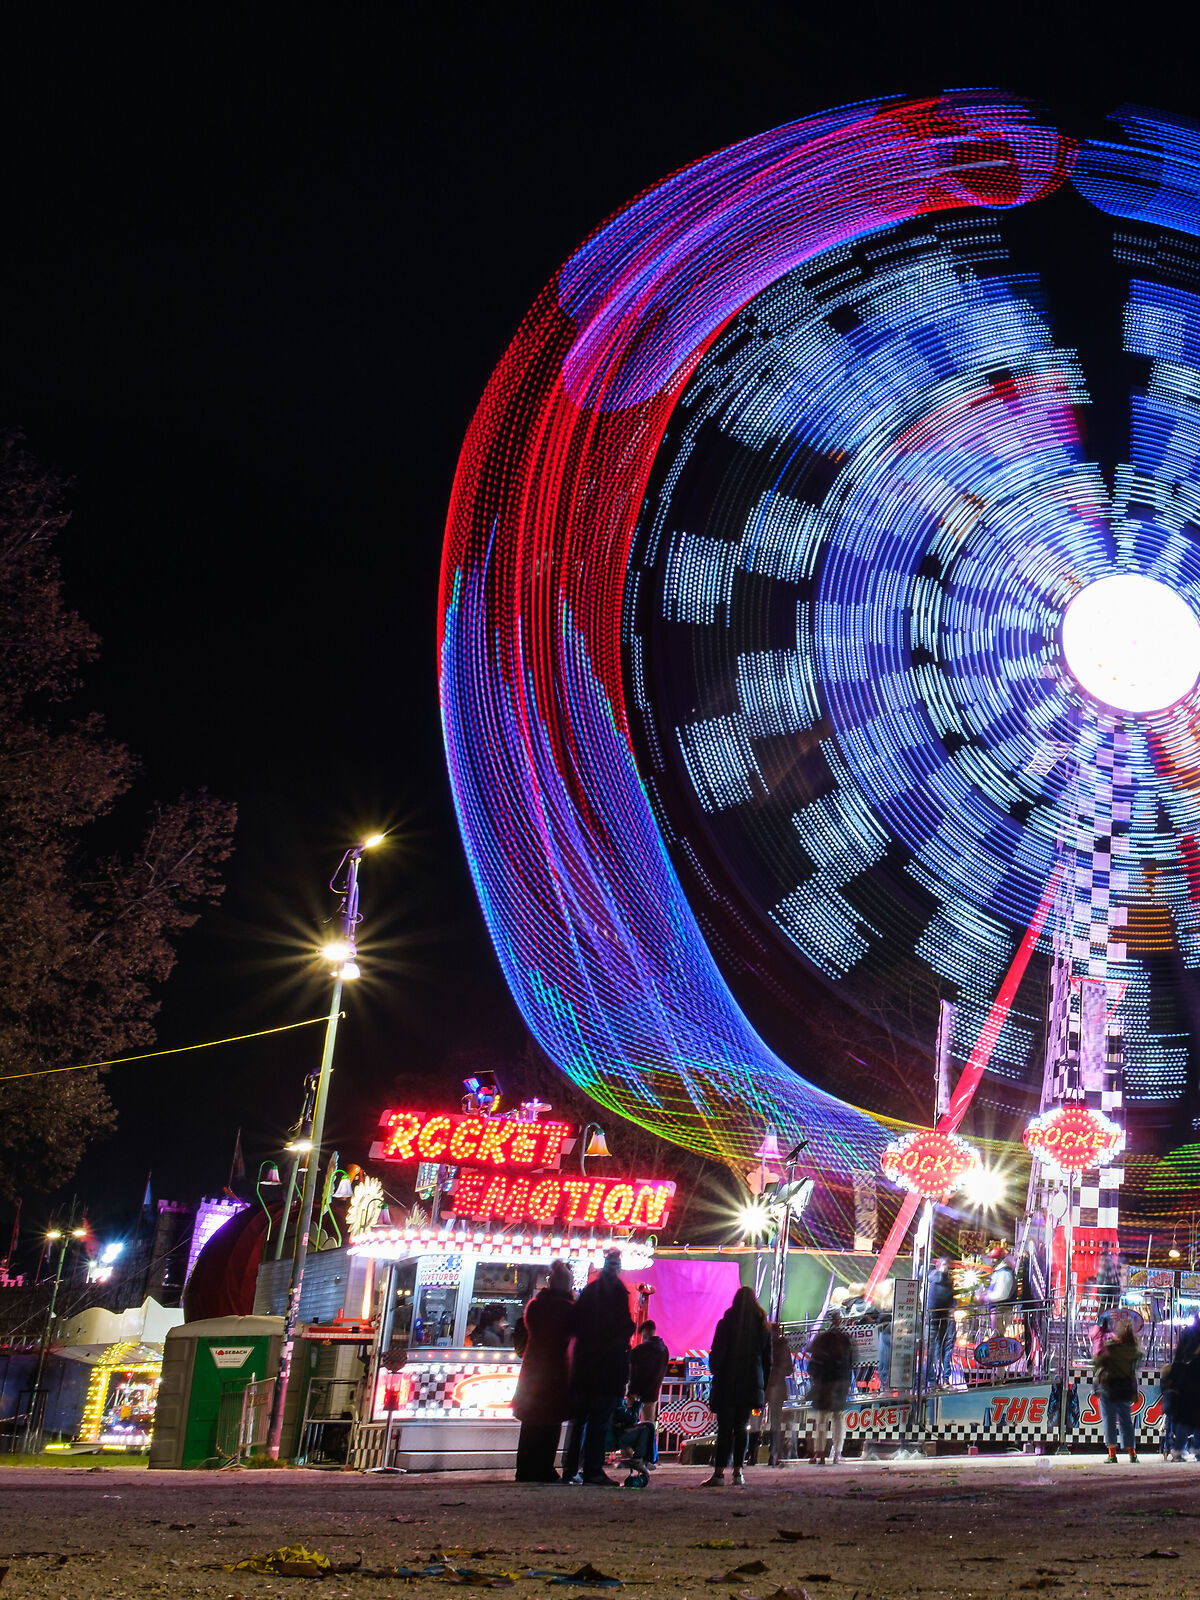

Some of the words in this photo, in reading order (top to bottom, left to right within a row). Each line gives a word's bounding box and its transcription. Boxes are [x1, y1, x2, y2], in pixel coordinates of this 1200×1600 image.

[384, 1112, 568, 1164] ROCKET
[1026, 1126, 1123, 1149] ROCKET
[883, 1150, 977, 1174] ROCKET
[452, 1174, 669, 1224] EMOTION
[1109, 1311, 1129, 1320] 30
[846, 1329, 873, 1338] VISO
[989, 1339, 1009, 1350] 30
[661, 1411, 699, 1422] ROCKET
[702, 1411, 718, 1421] PAR
[846, 1406, 911, 1429] OCKET
[991, 1397, 1048, 1423] THE
